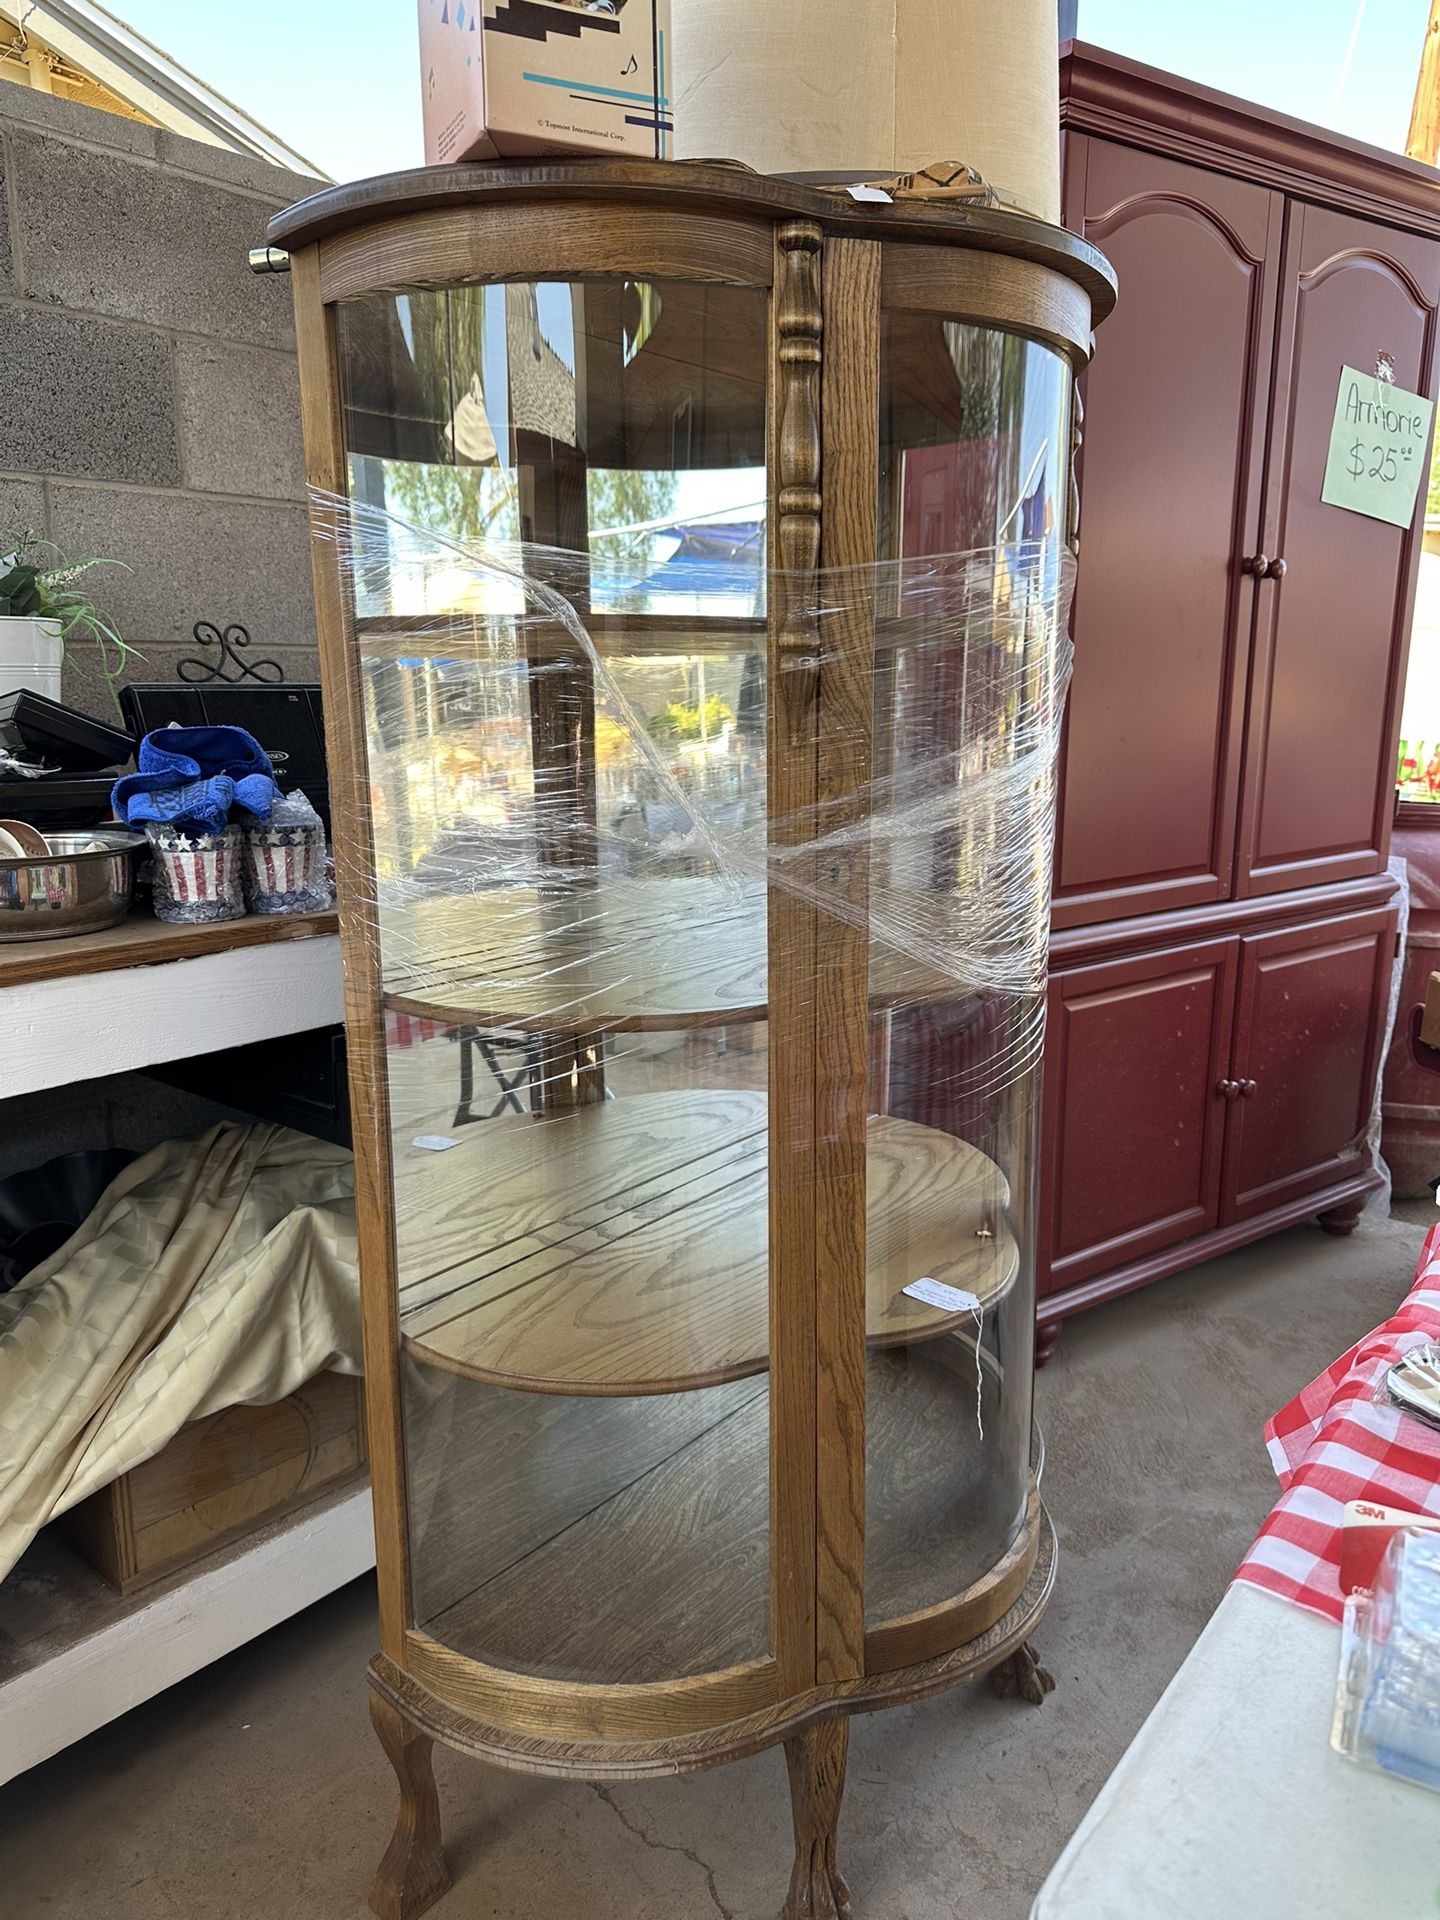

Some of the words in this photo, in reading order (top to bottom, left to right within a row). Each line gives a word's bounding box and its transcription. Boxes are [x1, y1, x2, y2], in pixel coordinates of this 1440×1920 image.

[545, 120, 571, 132] Topmost
[572, 125, 609, 137] International
[610, 132, 626, 142] Corp.
[1355, 1504, 1385, 1520] 3M
